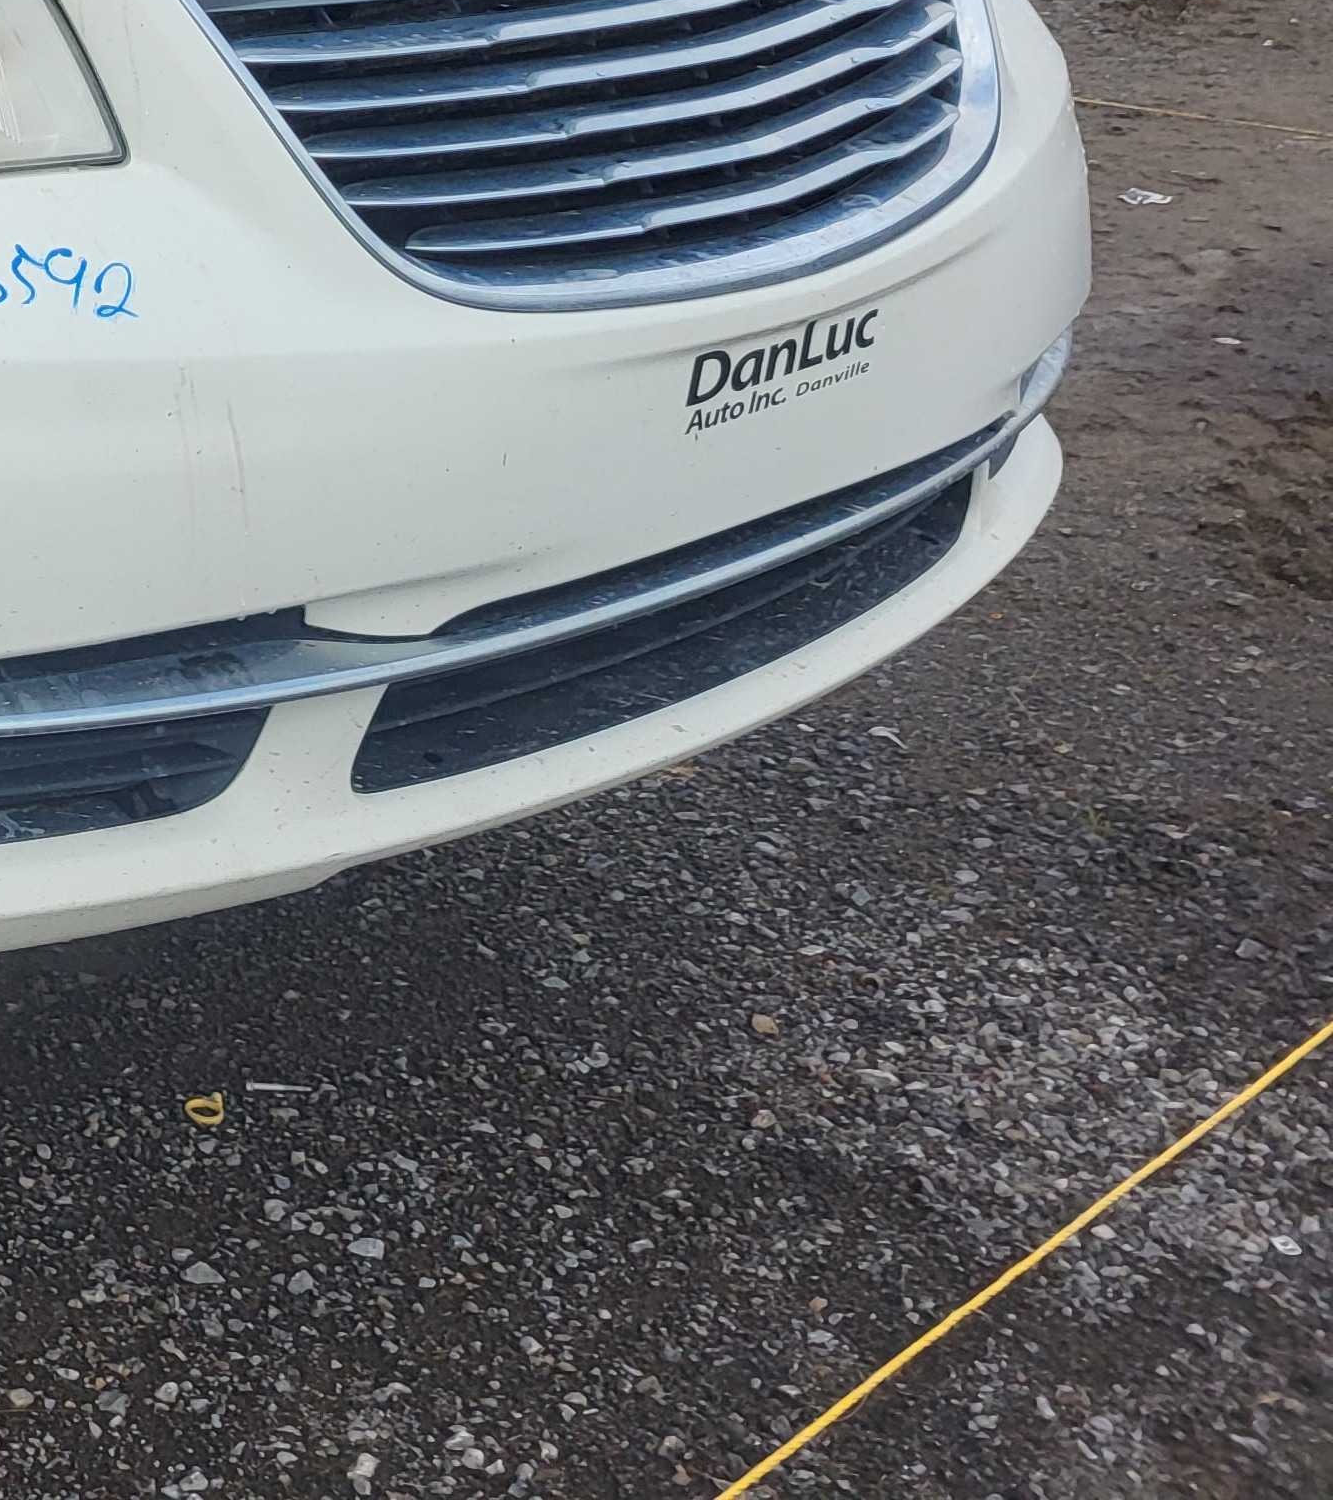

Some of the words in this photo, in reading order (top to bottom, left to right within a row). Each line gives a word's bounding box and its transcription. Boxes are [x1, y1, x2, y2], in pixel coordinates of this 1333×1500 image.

[684, 308, 879, 407] DanLuc
[684, 397, 745, 436] Auto
[747, 387, 787, 415] Inc.
[795, 360, 870, 398] Danville
